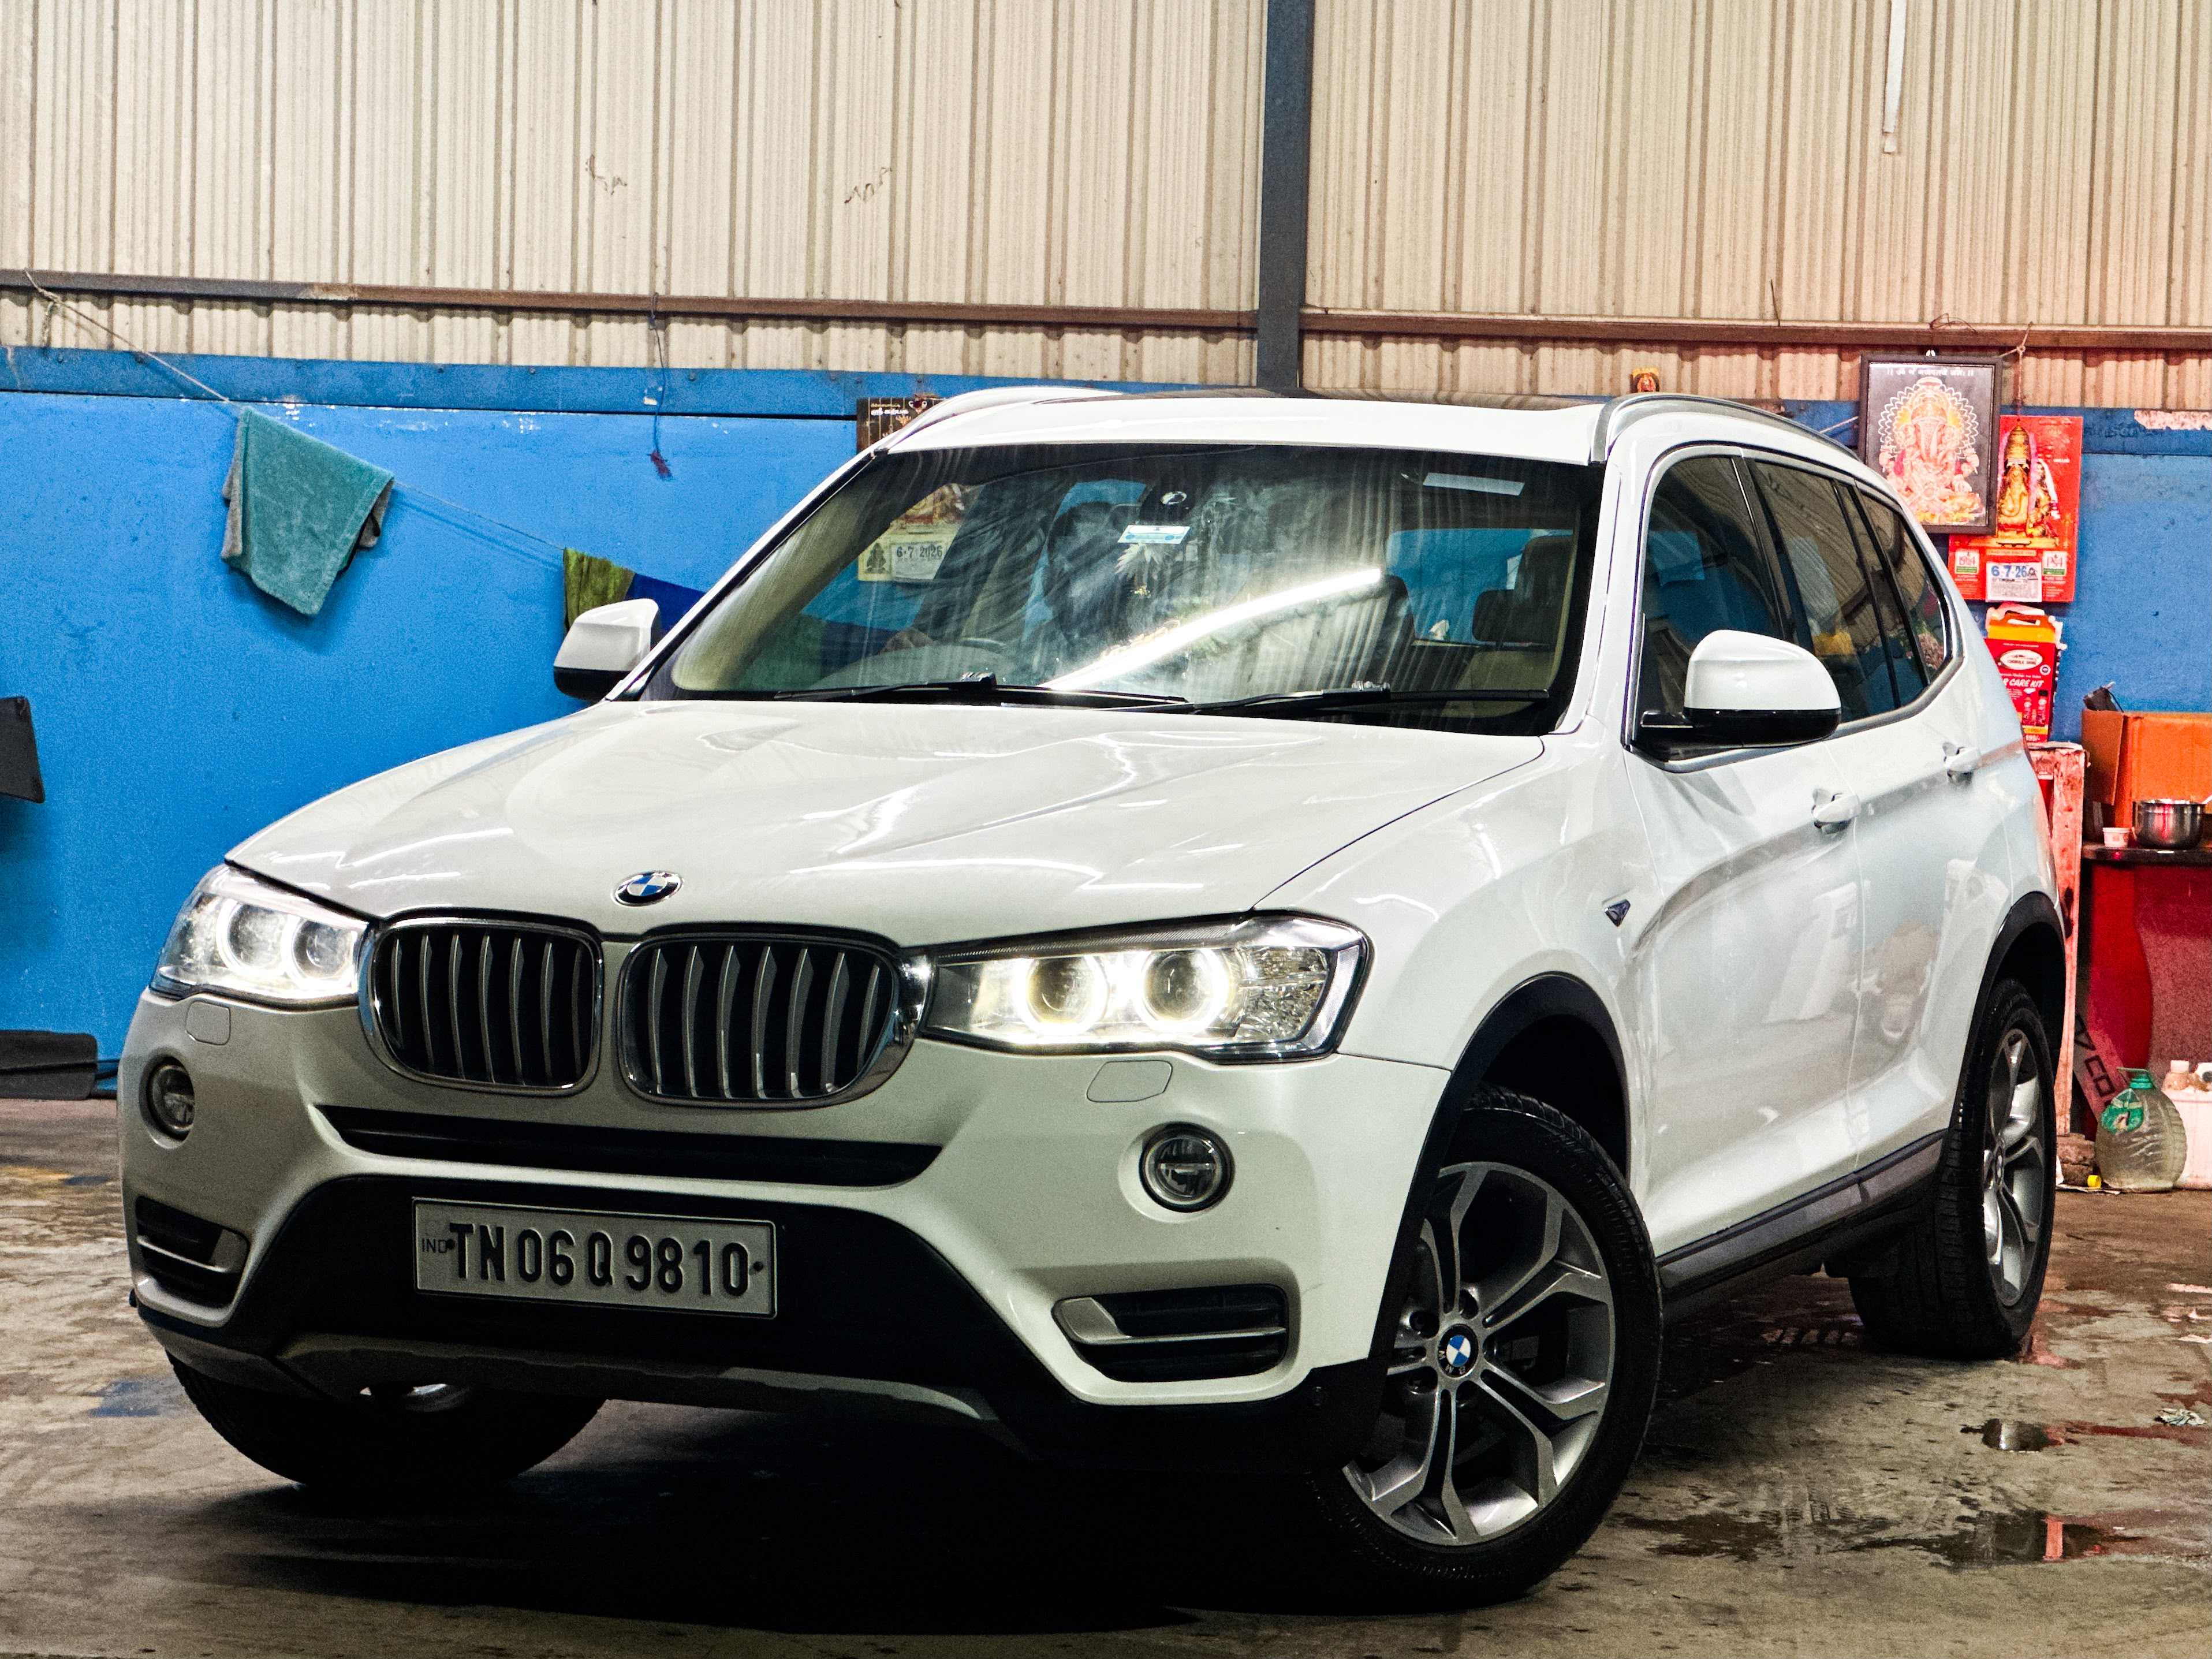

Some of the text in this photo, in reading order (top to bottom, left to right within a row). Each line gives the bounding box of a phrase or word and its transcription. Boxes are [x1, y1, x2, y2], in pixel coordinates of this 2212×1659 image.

[2009, 678, 2031, 687] CARE
[2030, 680, 2045, 688] KIT
[449, 1222, 506, 1281] TN
[520, 1228, 576, 1287] 06
[626, 1234, 750, 1298] 9810
